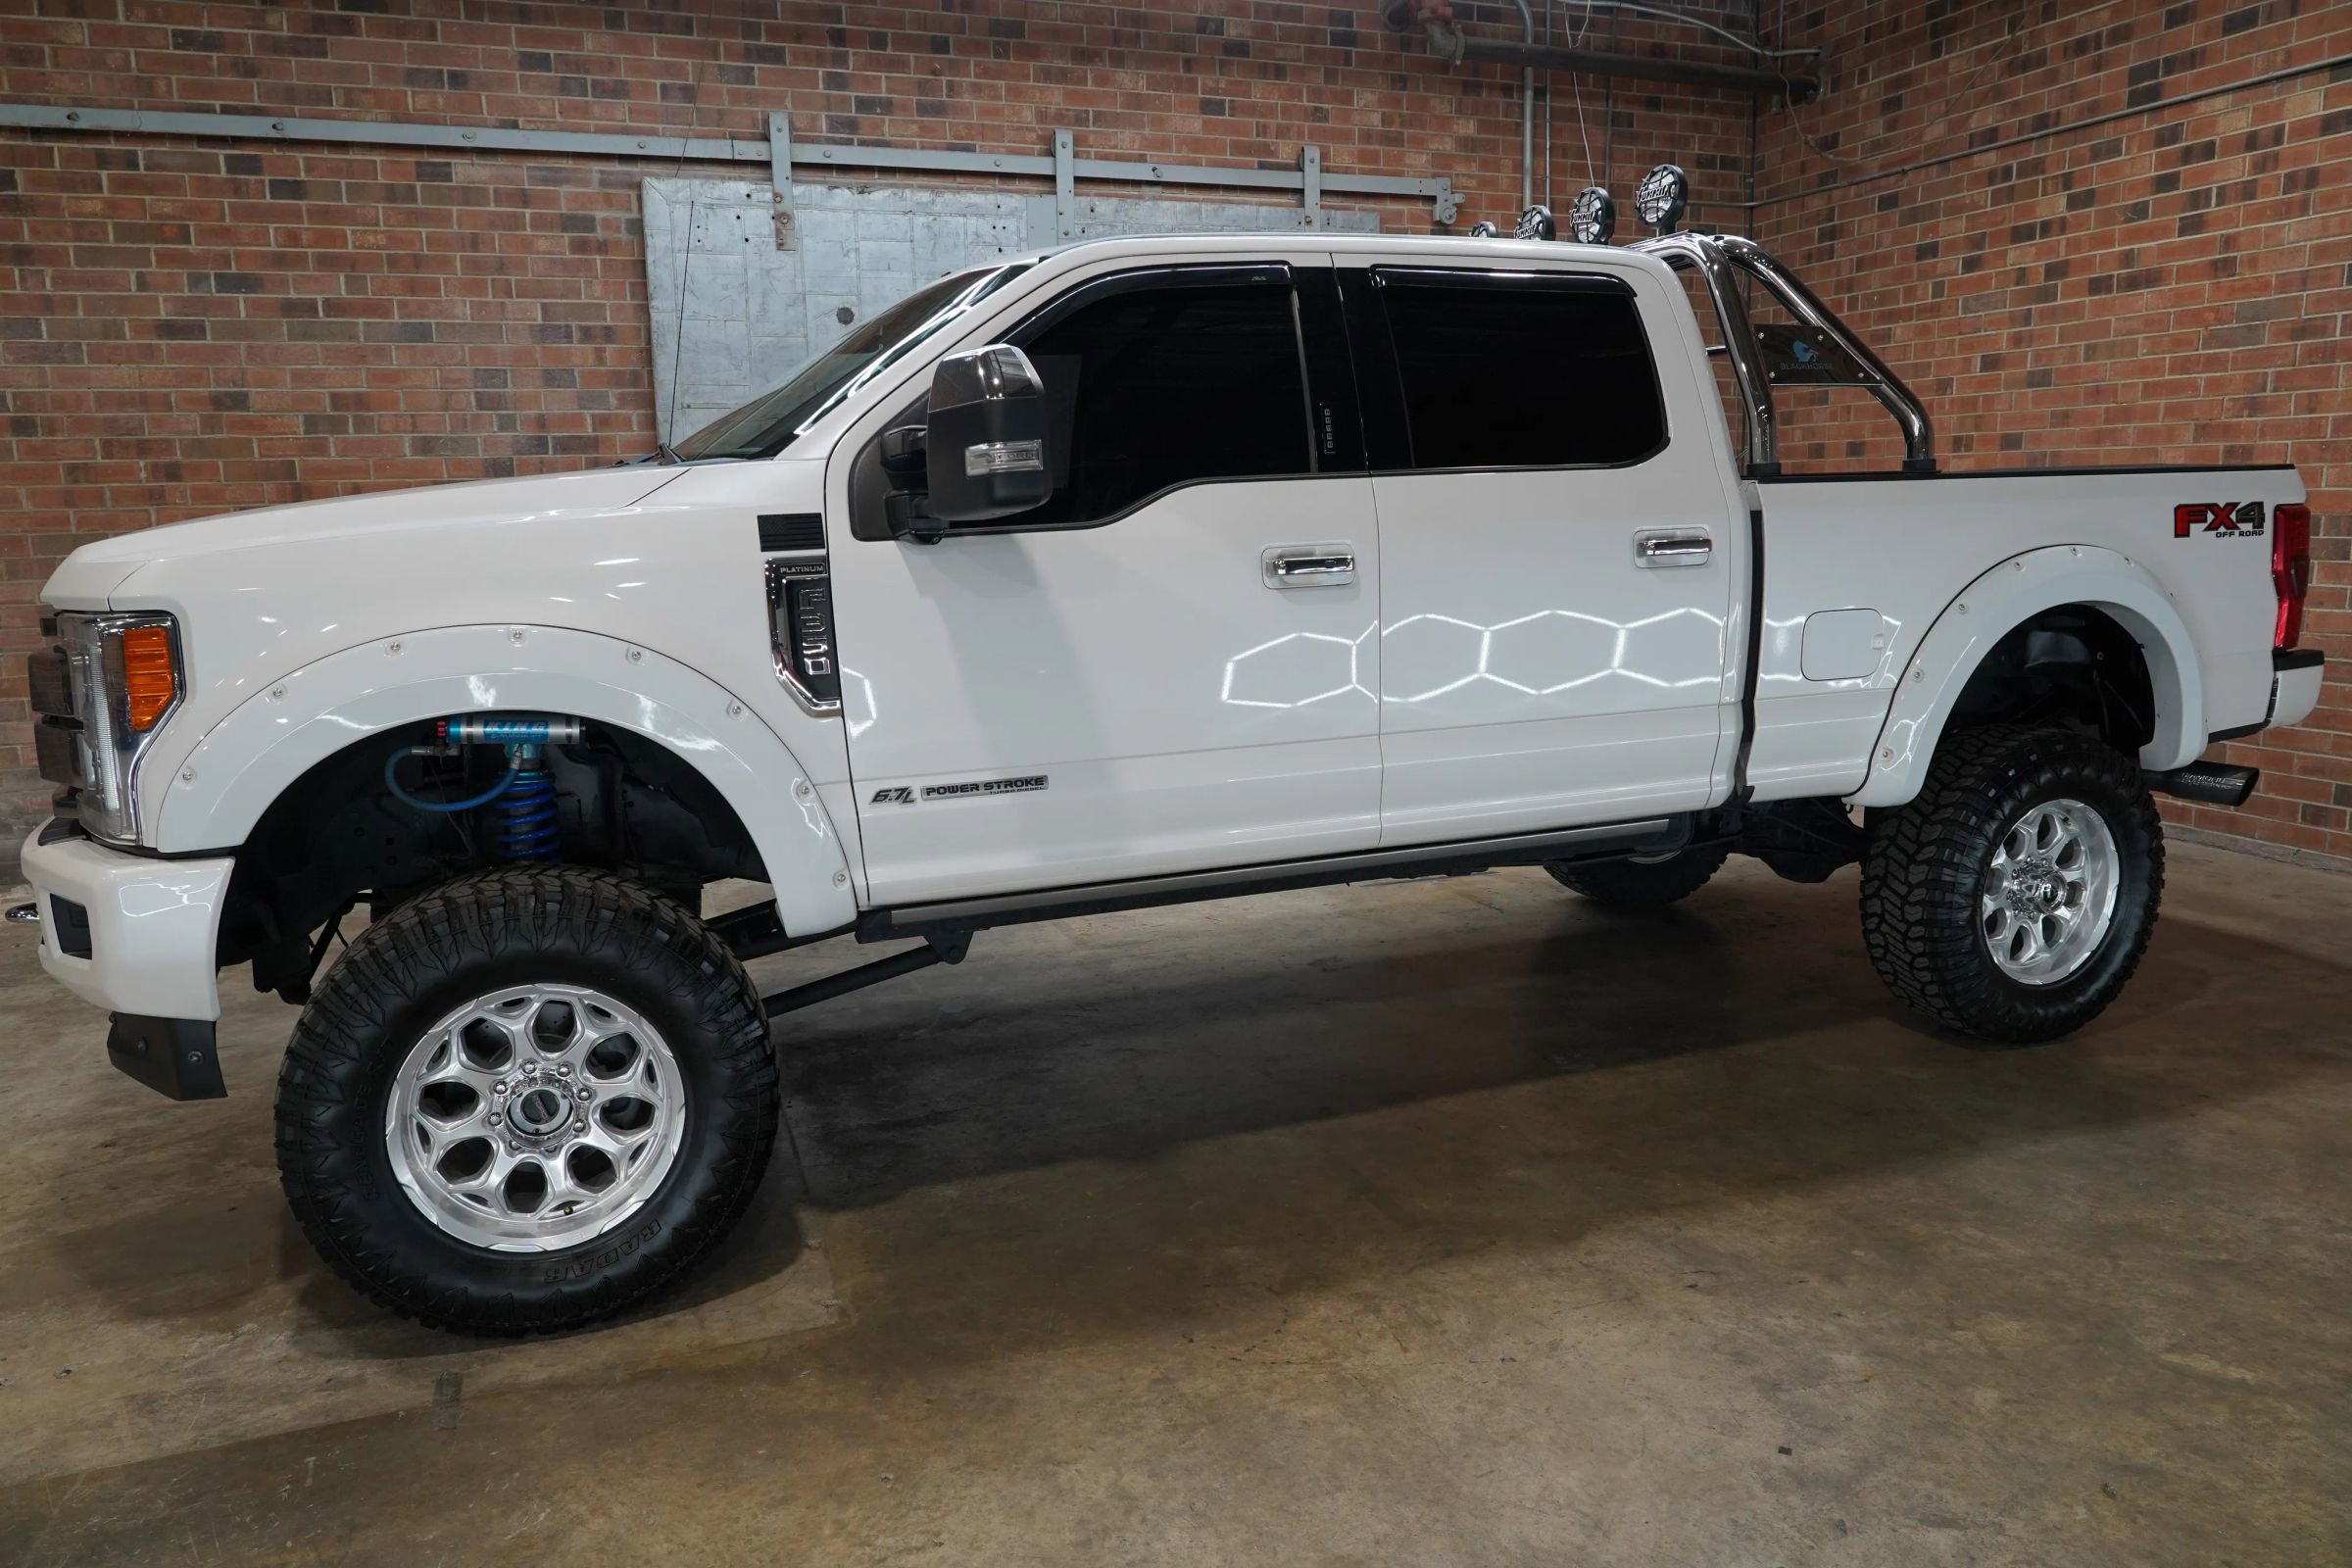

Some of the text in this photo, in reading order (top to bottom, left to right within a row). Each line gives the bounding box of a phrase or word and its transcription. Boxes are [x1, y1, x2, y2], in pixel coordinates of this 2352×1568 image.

[2174, 501, 2265, 538] FX4
[780, 564, 824, 573] PLATINUM
[485, 721, 547, 734] KING
[871, 776, 1046, 805] 6.7L POWER STROKE
[544, 1218, 662, 1284] RADAR
